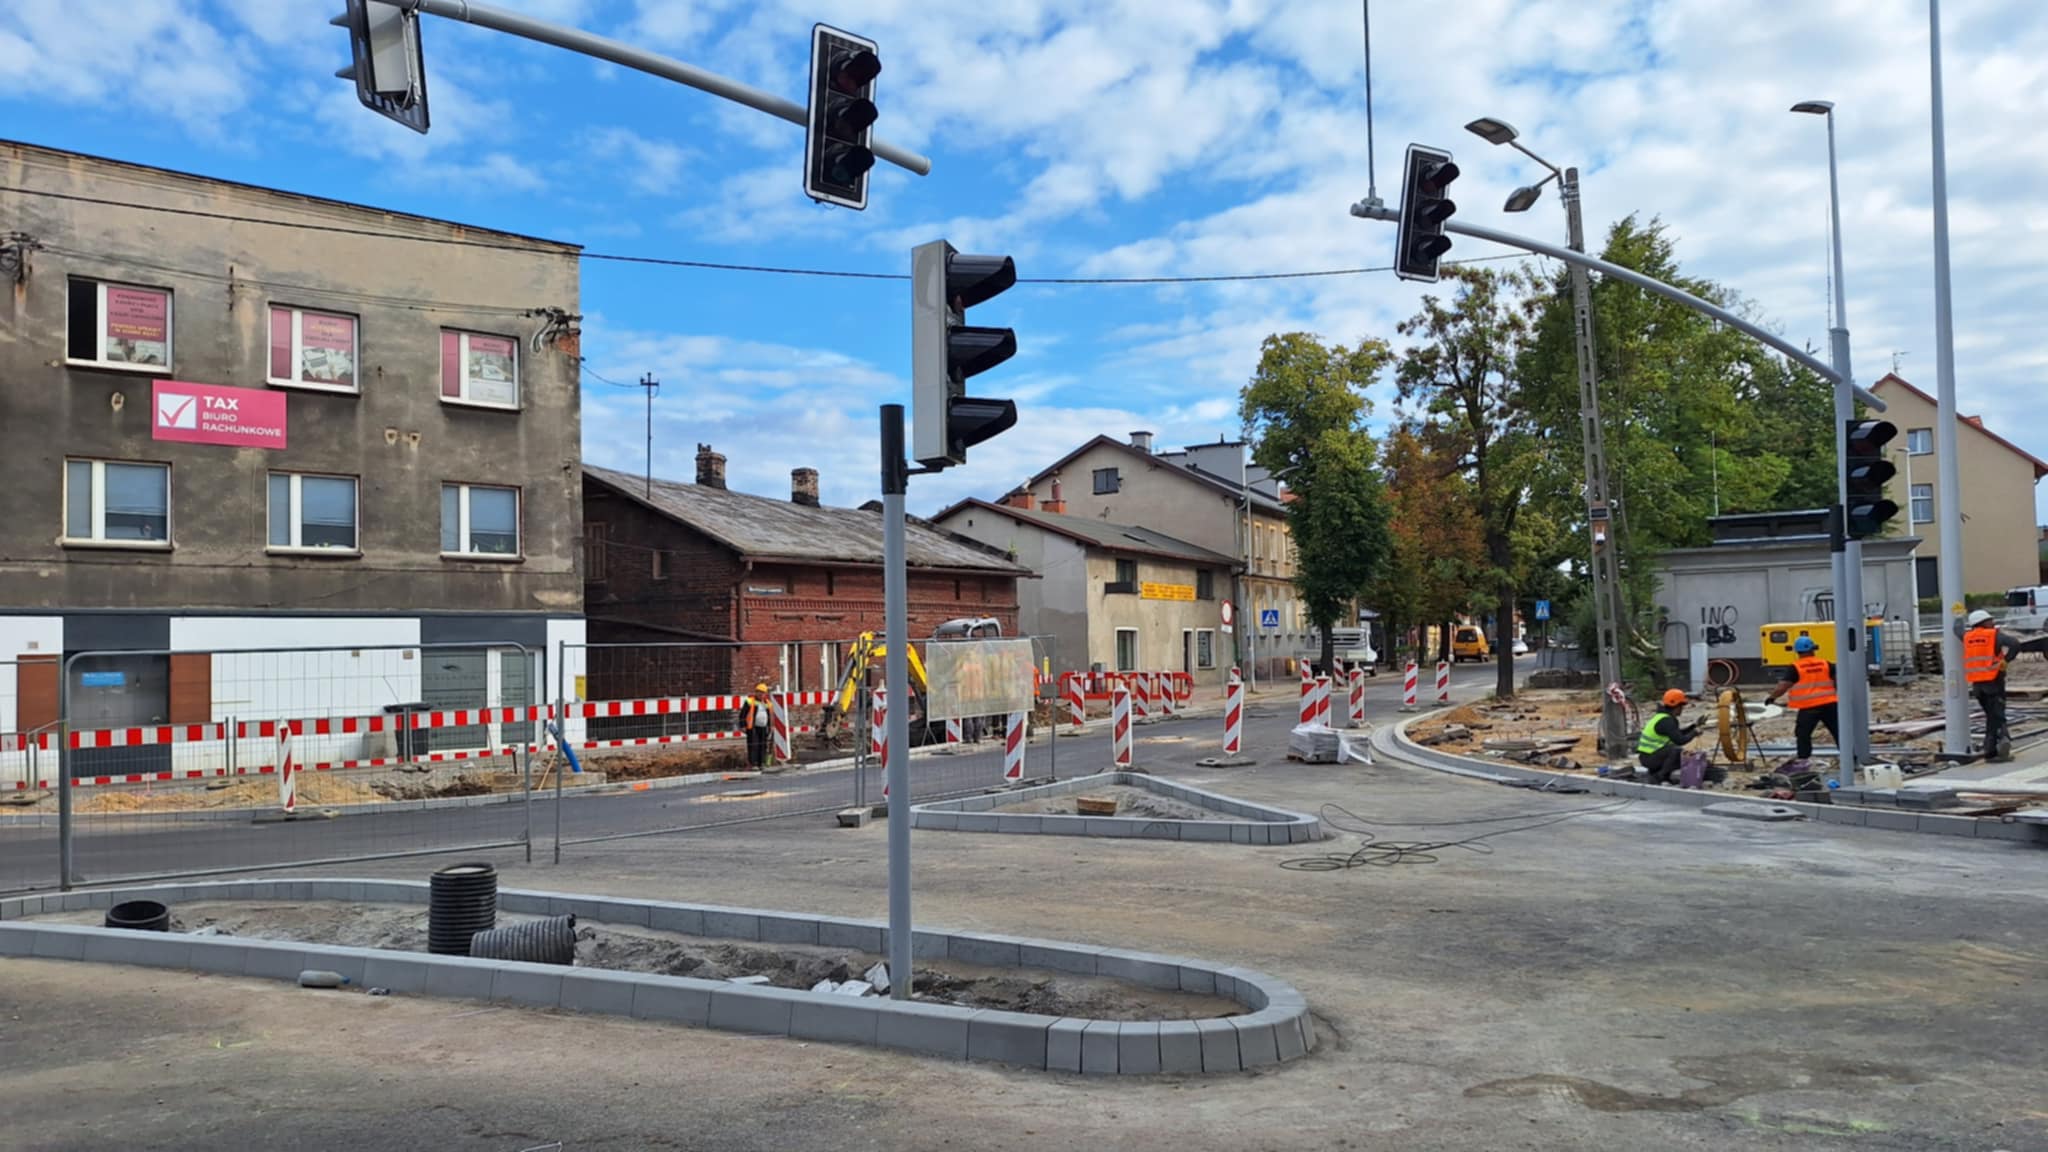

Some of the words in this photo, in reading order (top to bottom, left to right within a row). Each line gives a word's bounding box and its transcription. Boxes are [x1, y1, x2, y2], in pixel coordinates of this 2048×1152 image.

[203, 396, 238, 410] TAX
[202, 412, 237, 422] BIURO
[202, 423, 281, 437] RACHUNKOWE
